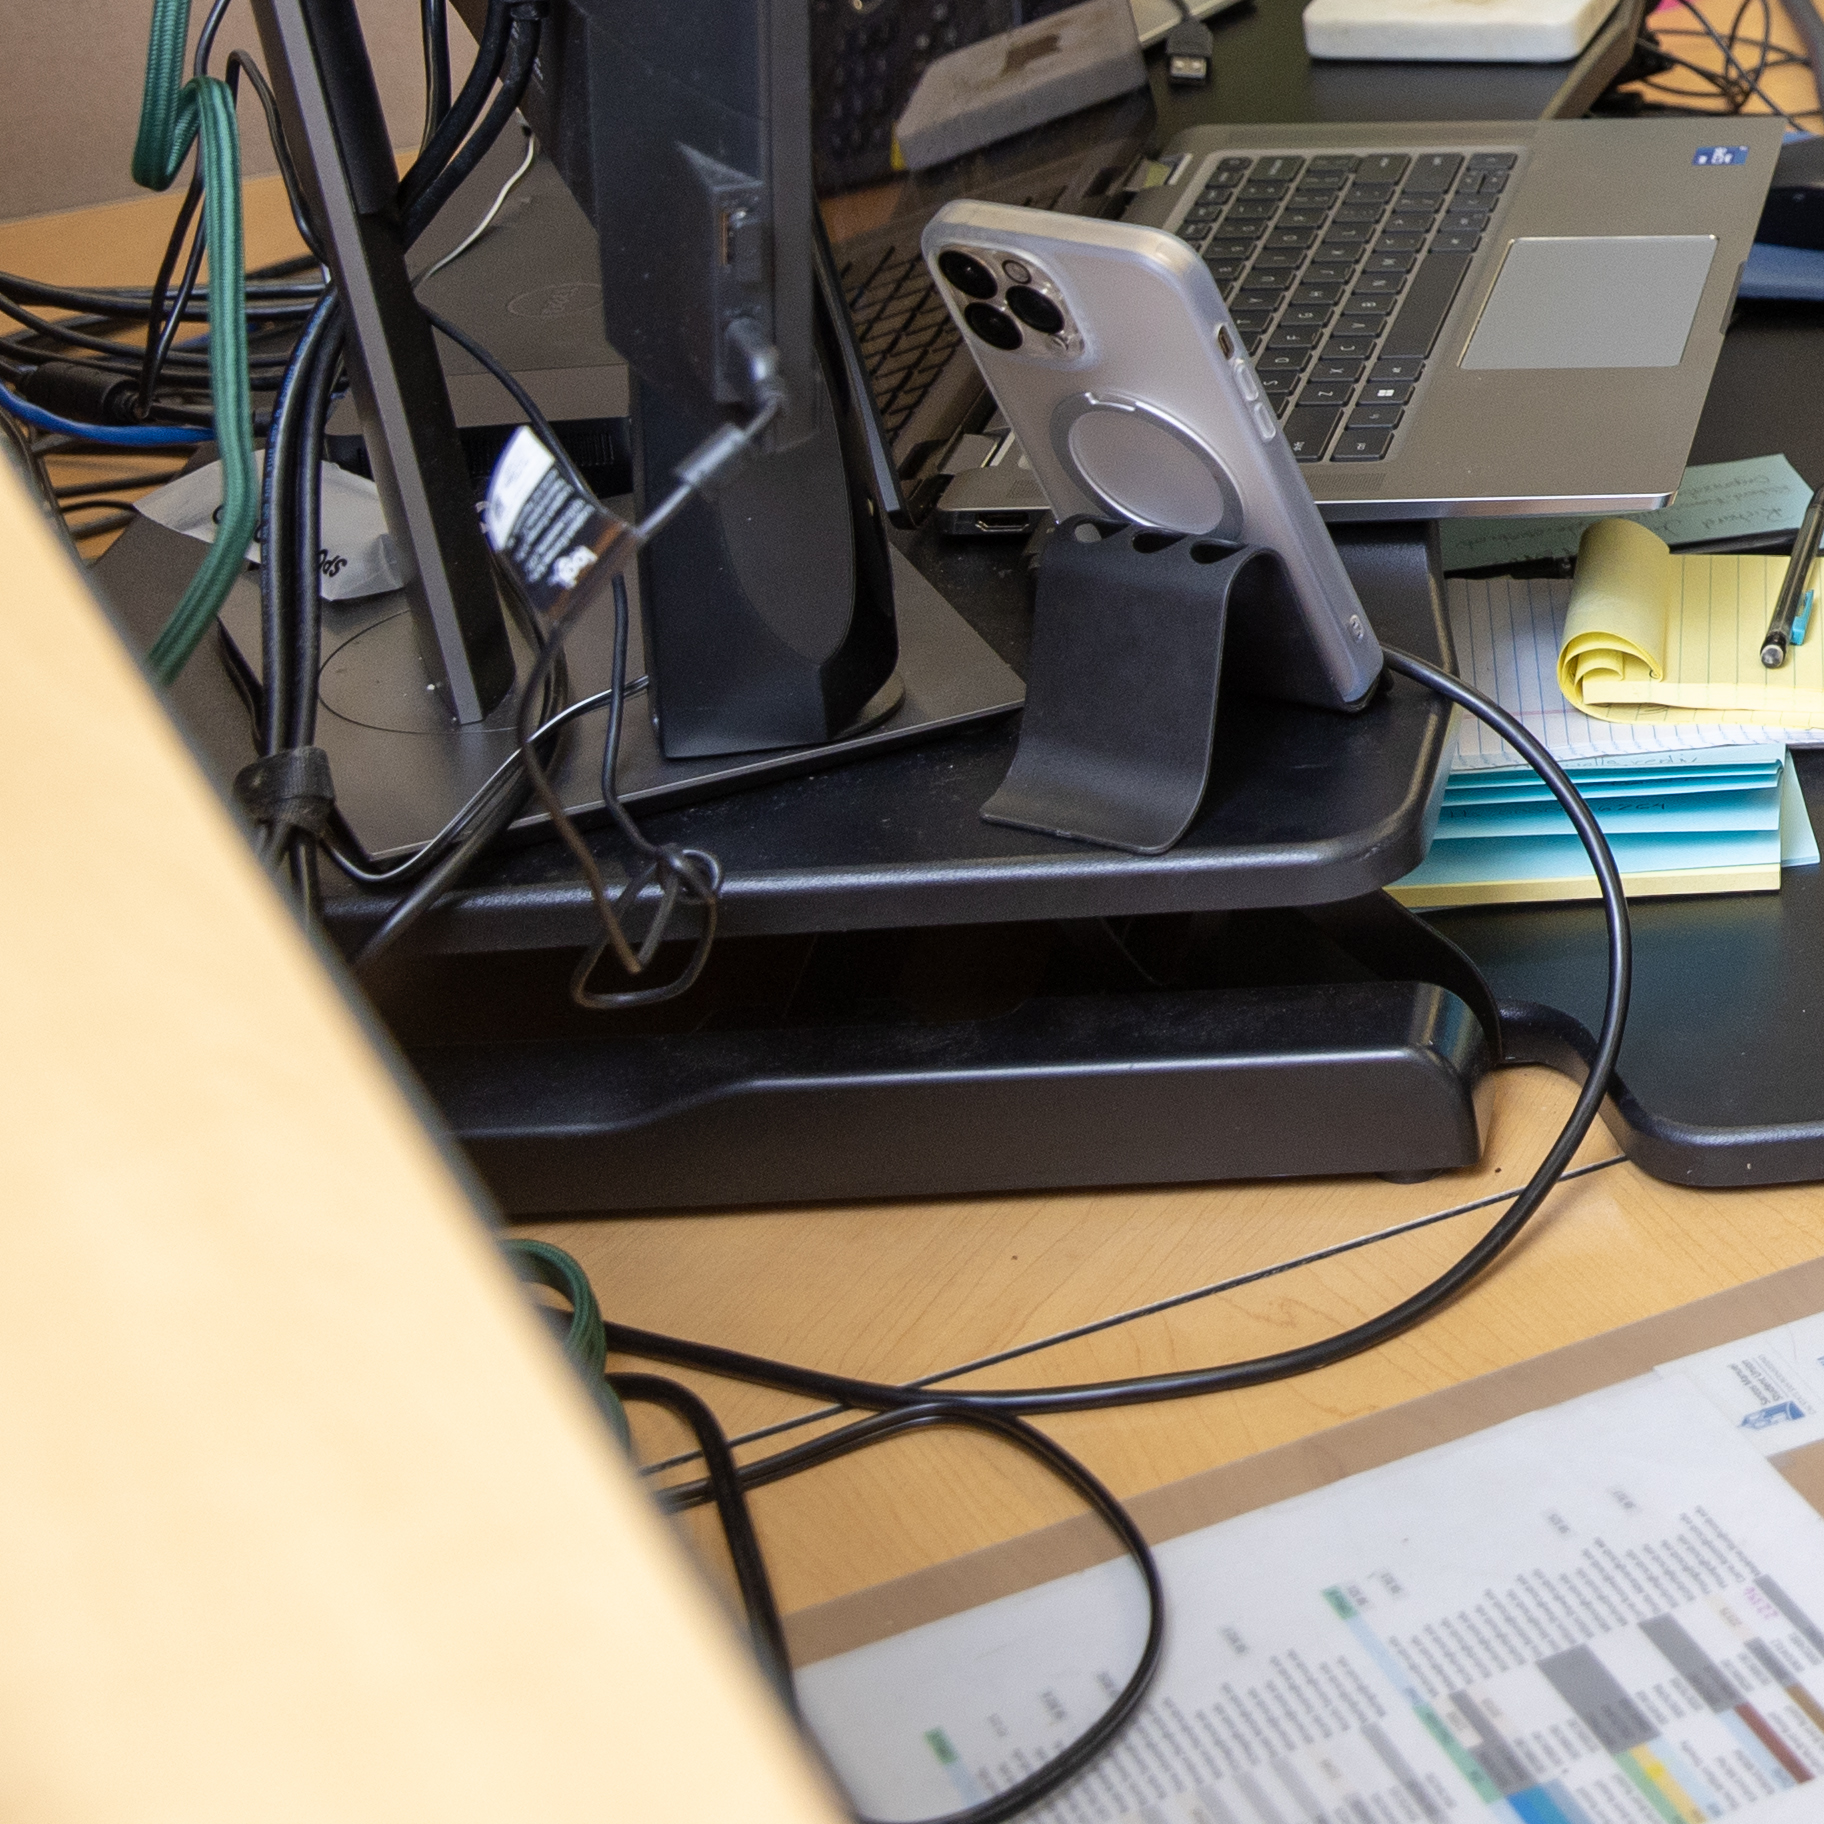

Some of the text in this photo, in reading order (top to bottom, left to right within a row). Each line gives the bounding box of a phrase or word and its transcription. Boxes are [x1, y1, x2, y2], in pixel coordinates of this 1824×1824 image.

[1725, 1362, 1772, 1405] Santos Manuel
[1736, 1358, 1784, 1401] Student Union
